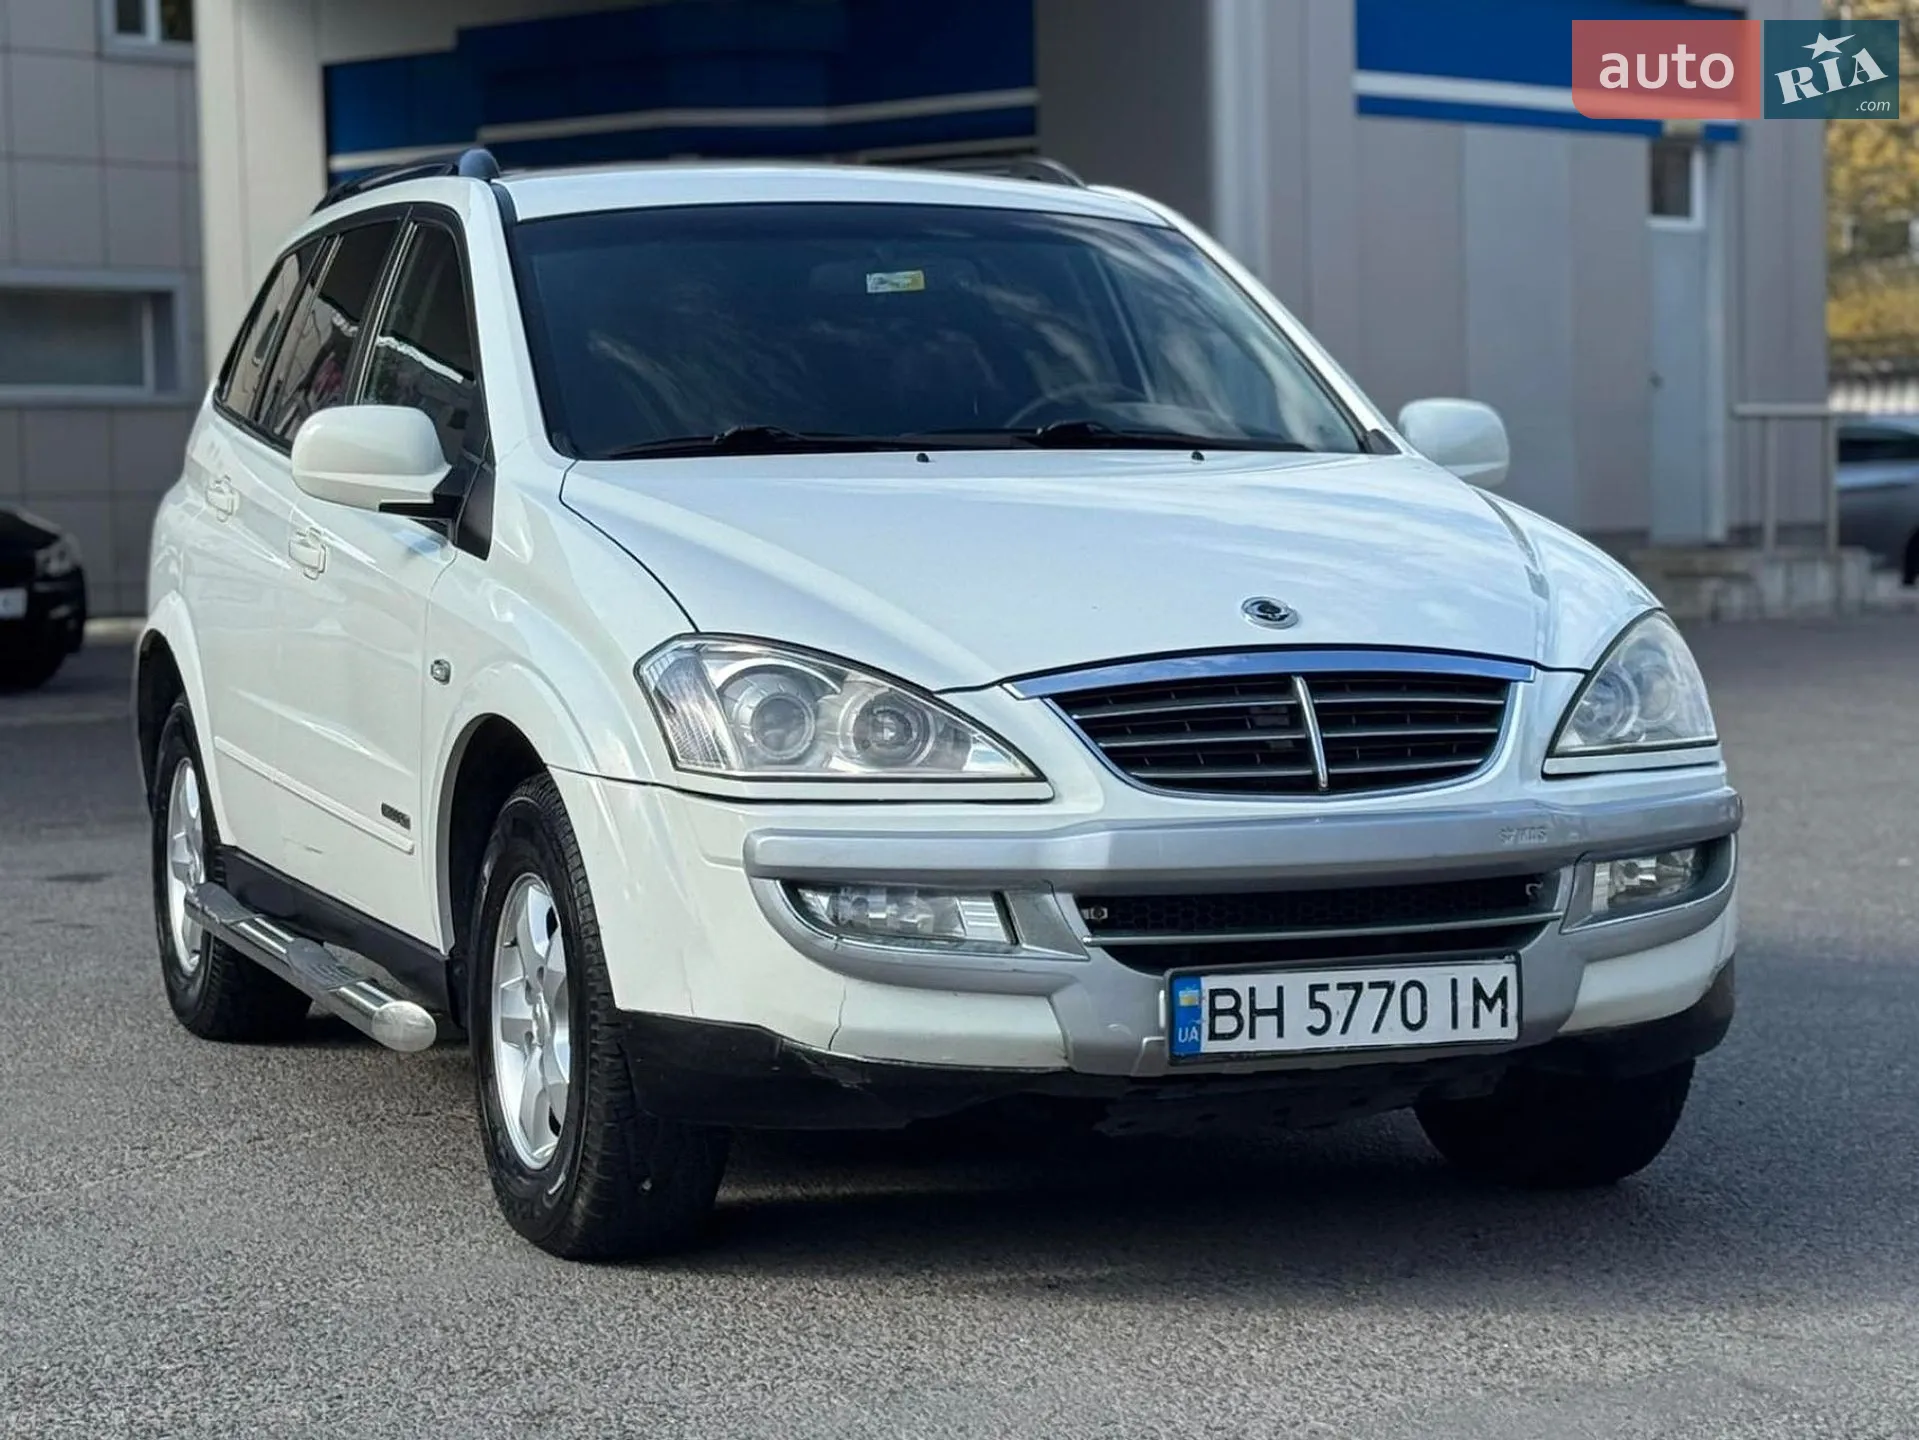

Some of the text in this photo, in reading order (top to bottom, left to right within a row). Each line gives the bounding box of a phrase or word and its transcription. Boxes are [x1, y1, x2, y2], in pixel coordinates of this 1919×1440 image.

[1207, 976, 1508, 1042] BH 5770 IM
[1178, 1026, 1200, 1043] UA
